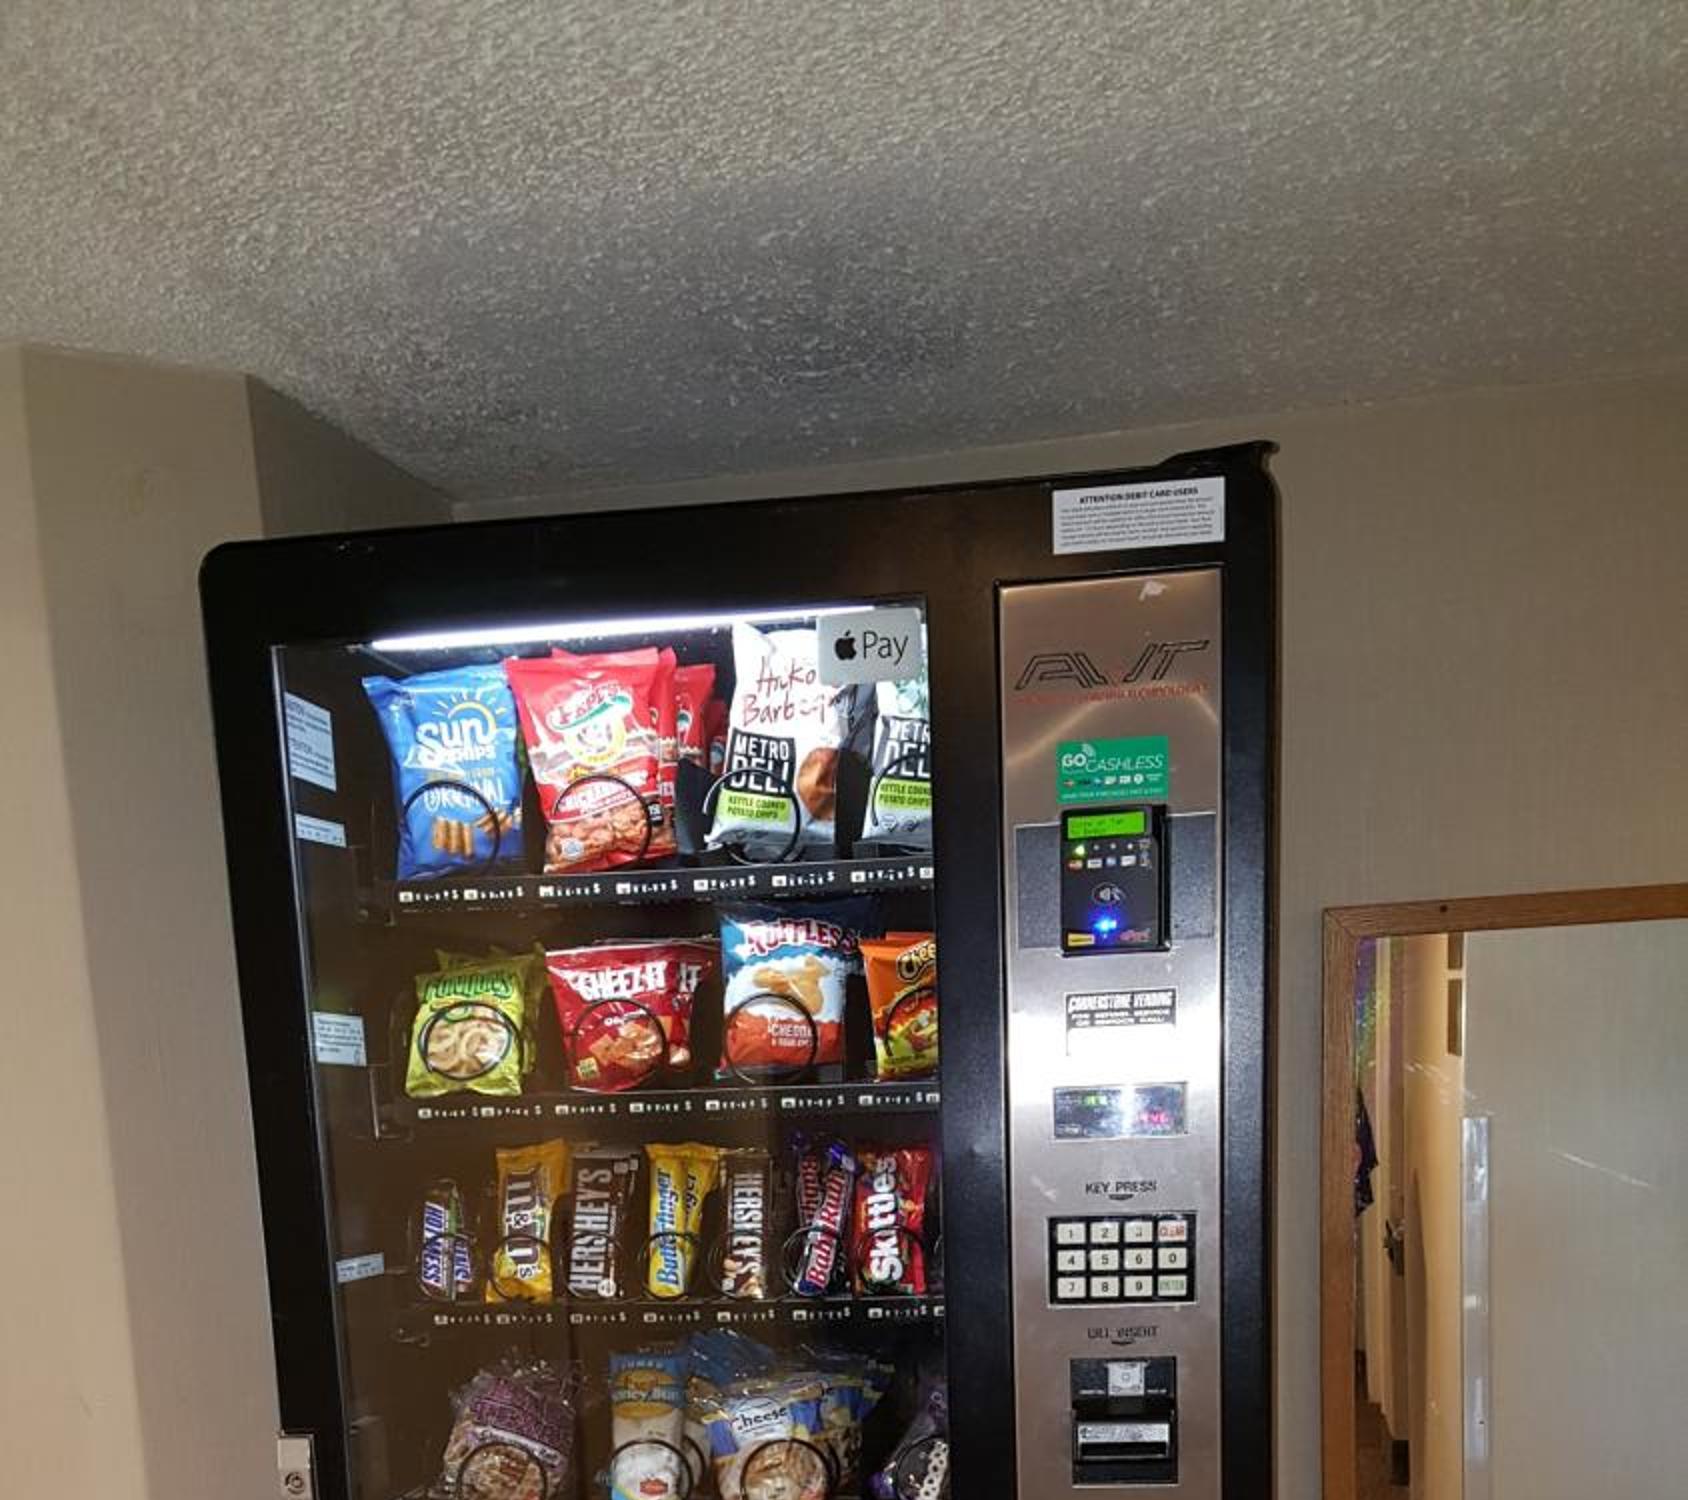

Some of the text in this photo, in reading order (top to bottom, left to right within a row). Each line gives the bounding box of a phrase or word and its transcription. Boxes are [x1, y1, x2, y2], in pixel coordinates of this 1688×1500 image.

[862, 630, 909, 664] Pay
[890, 716, 932, 740] METR
[735, 734, 790, 761] METRO
[1062, 752, 1088, 768] GO
[1086, 1180, 1158, 1195] KEY PRESS
[568, 1167, 613, 1293] HERSHEY'S
